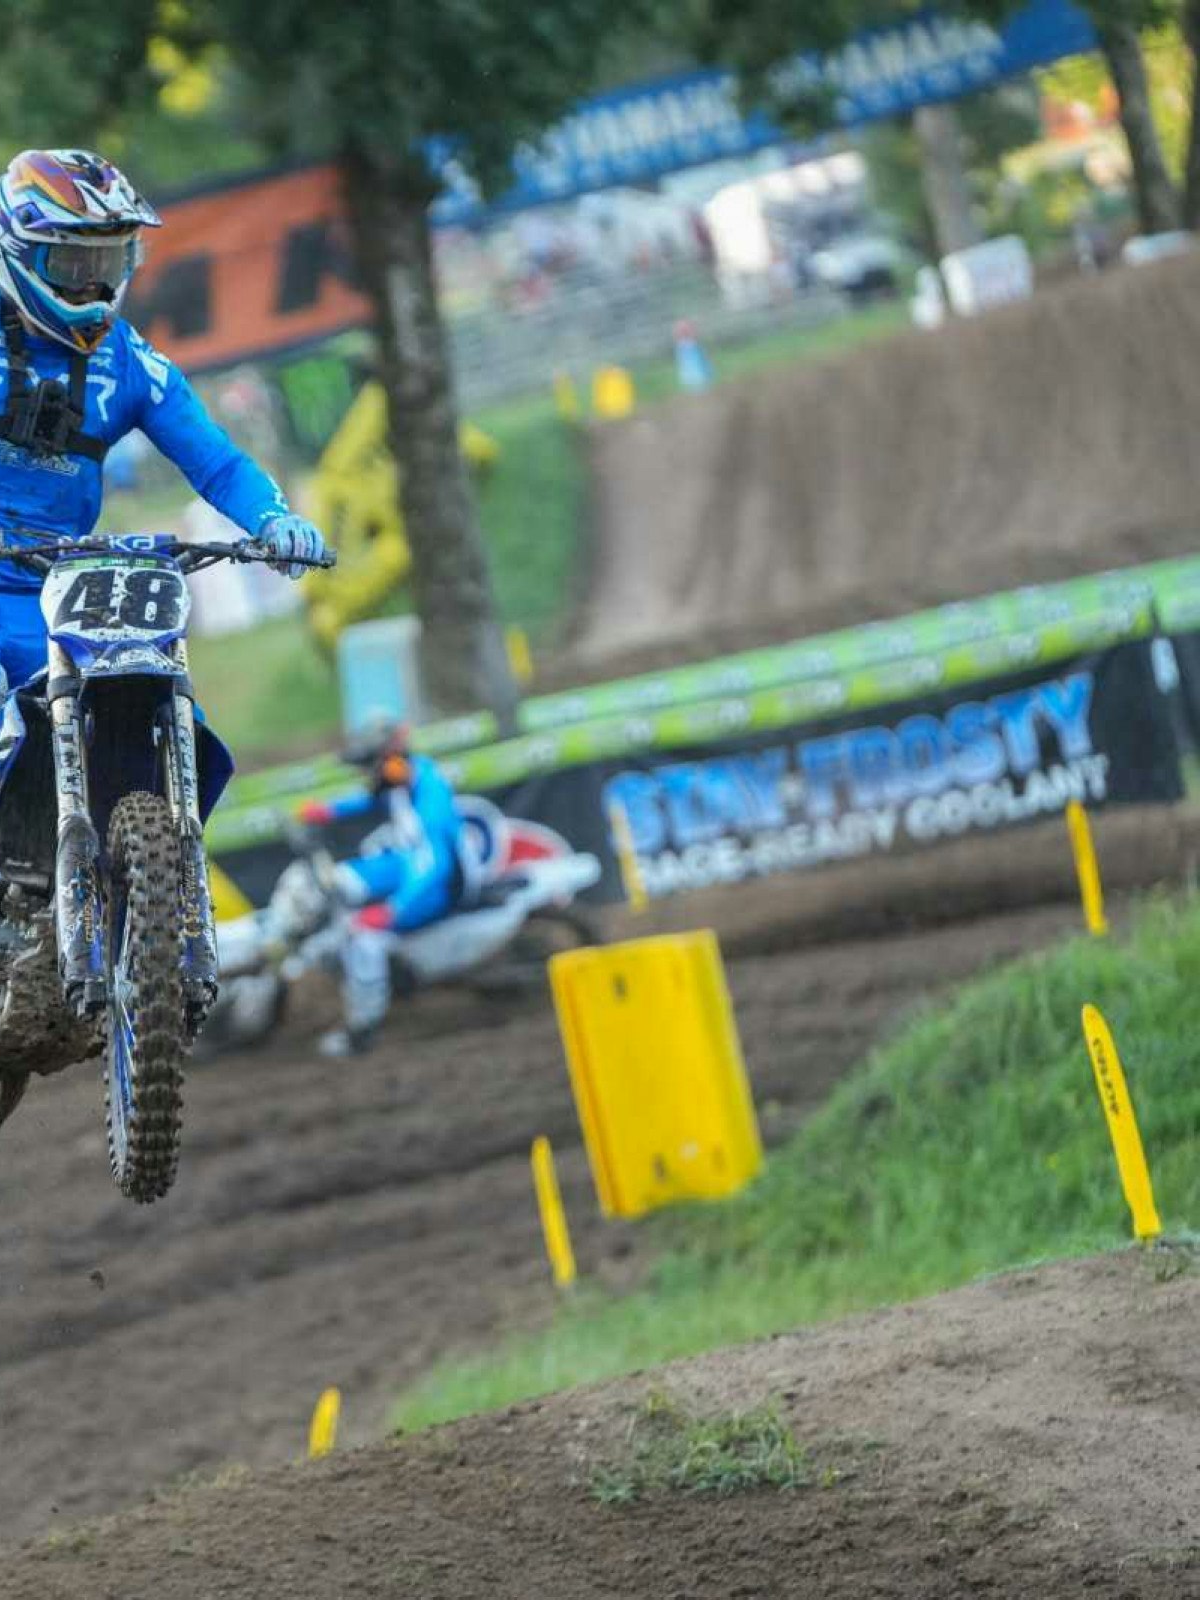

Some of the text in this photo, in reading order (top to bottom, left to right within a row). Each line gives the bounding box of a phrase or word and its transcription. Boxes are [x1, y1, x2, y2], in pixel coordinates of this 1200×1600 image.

[53, 568, 184, 631] 48
[798, 670, 1094, 816] FROSTY
[906, 752, 1110, 842] COOLANT
